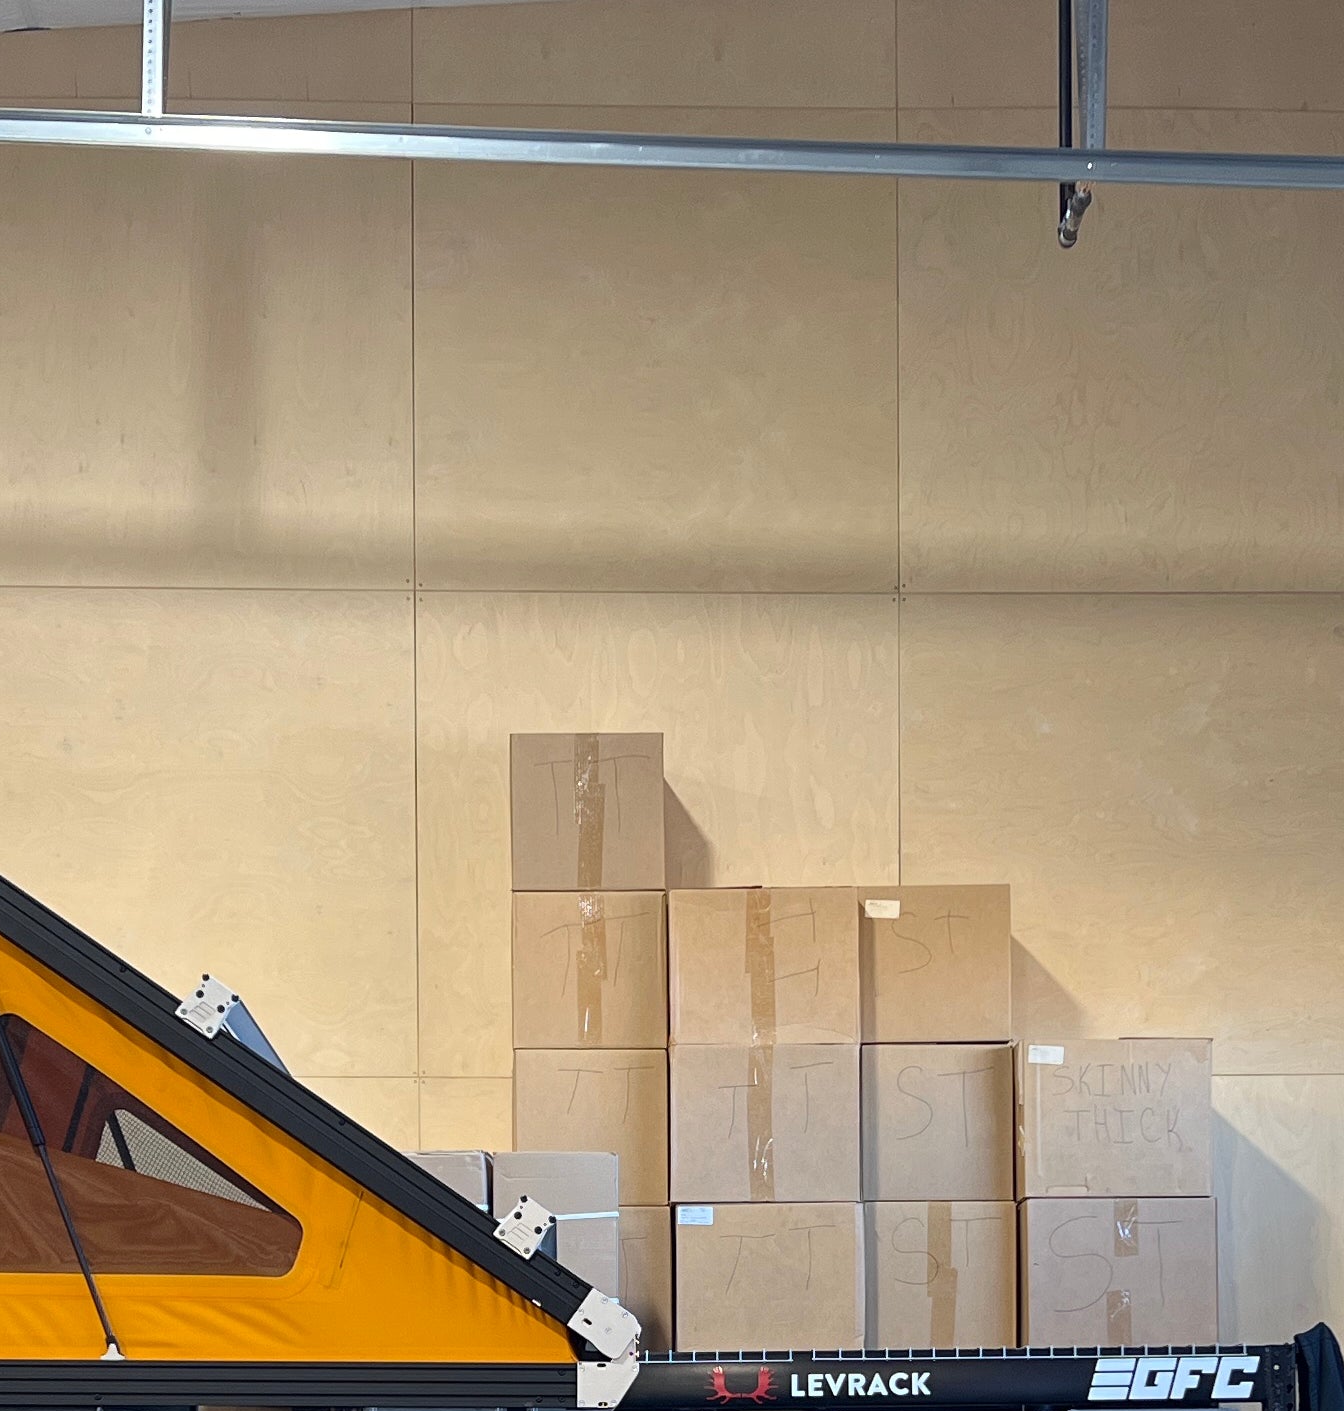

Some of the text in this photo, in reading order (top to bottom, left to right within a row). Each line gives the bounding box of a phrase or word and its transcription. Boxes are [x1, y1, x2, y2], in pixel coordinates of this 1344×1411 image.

[1053, 1061, 1172, 1098] SKINNY
[1063, 1105, 1185, 1152] THICK
[791, 1372, 931, 1398] LEVRACK
